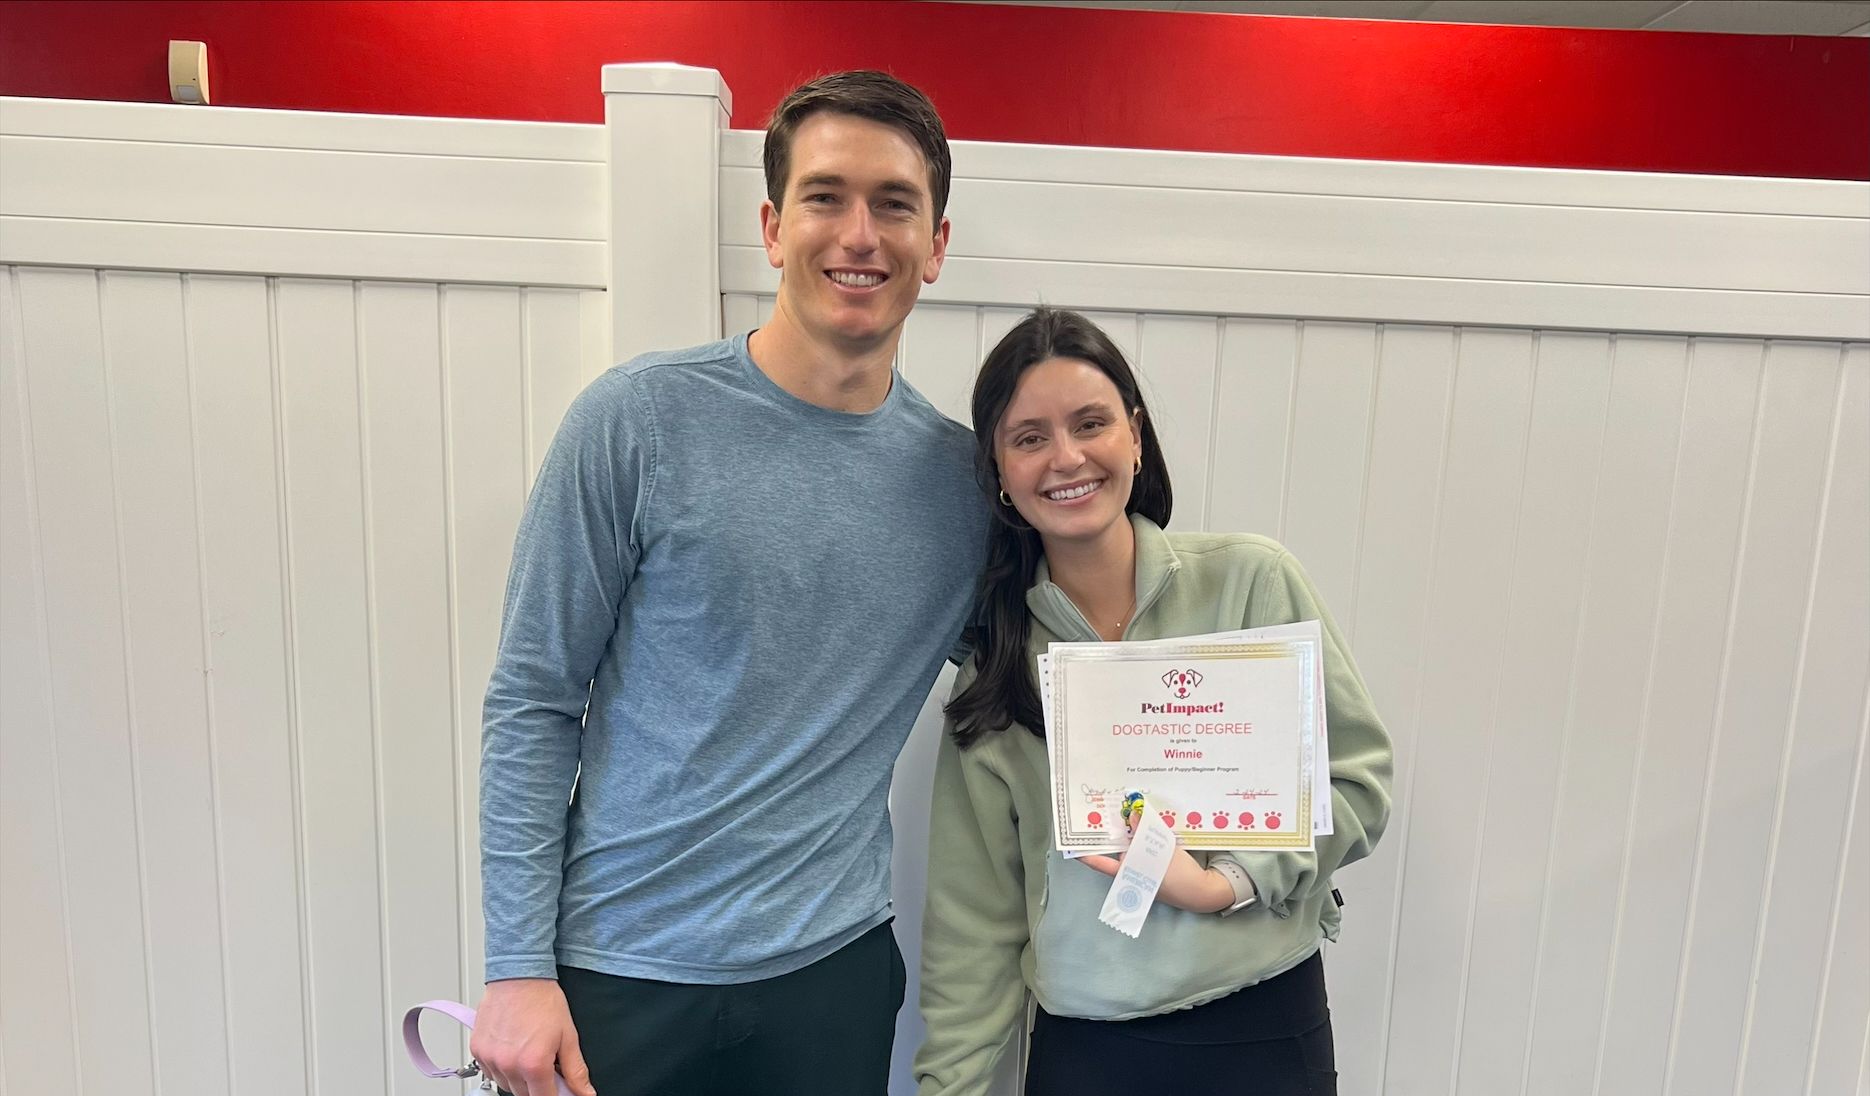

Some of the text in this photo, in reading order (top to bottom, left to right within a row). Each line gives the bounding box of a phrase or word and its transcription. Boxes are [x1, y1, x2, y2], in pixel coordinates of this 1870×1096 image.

[1141, 702, 1224, 716] PetImpact!
[1112, 722, 1253, 736] DOGTASTIC DEGREE
[1163, 748, 1203, 759] Winnie
